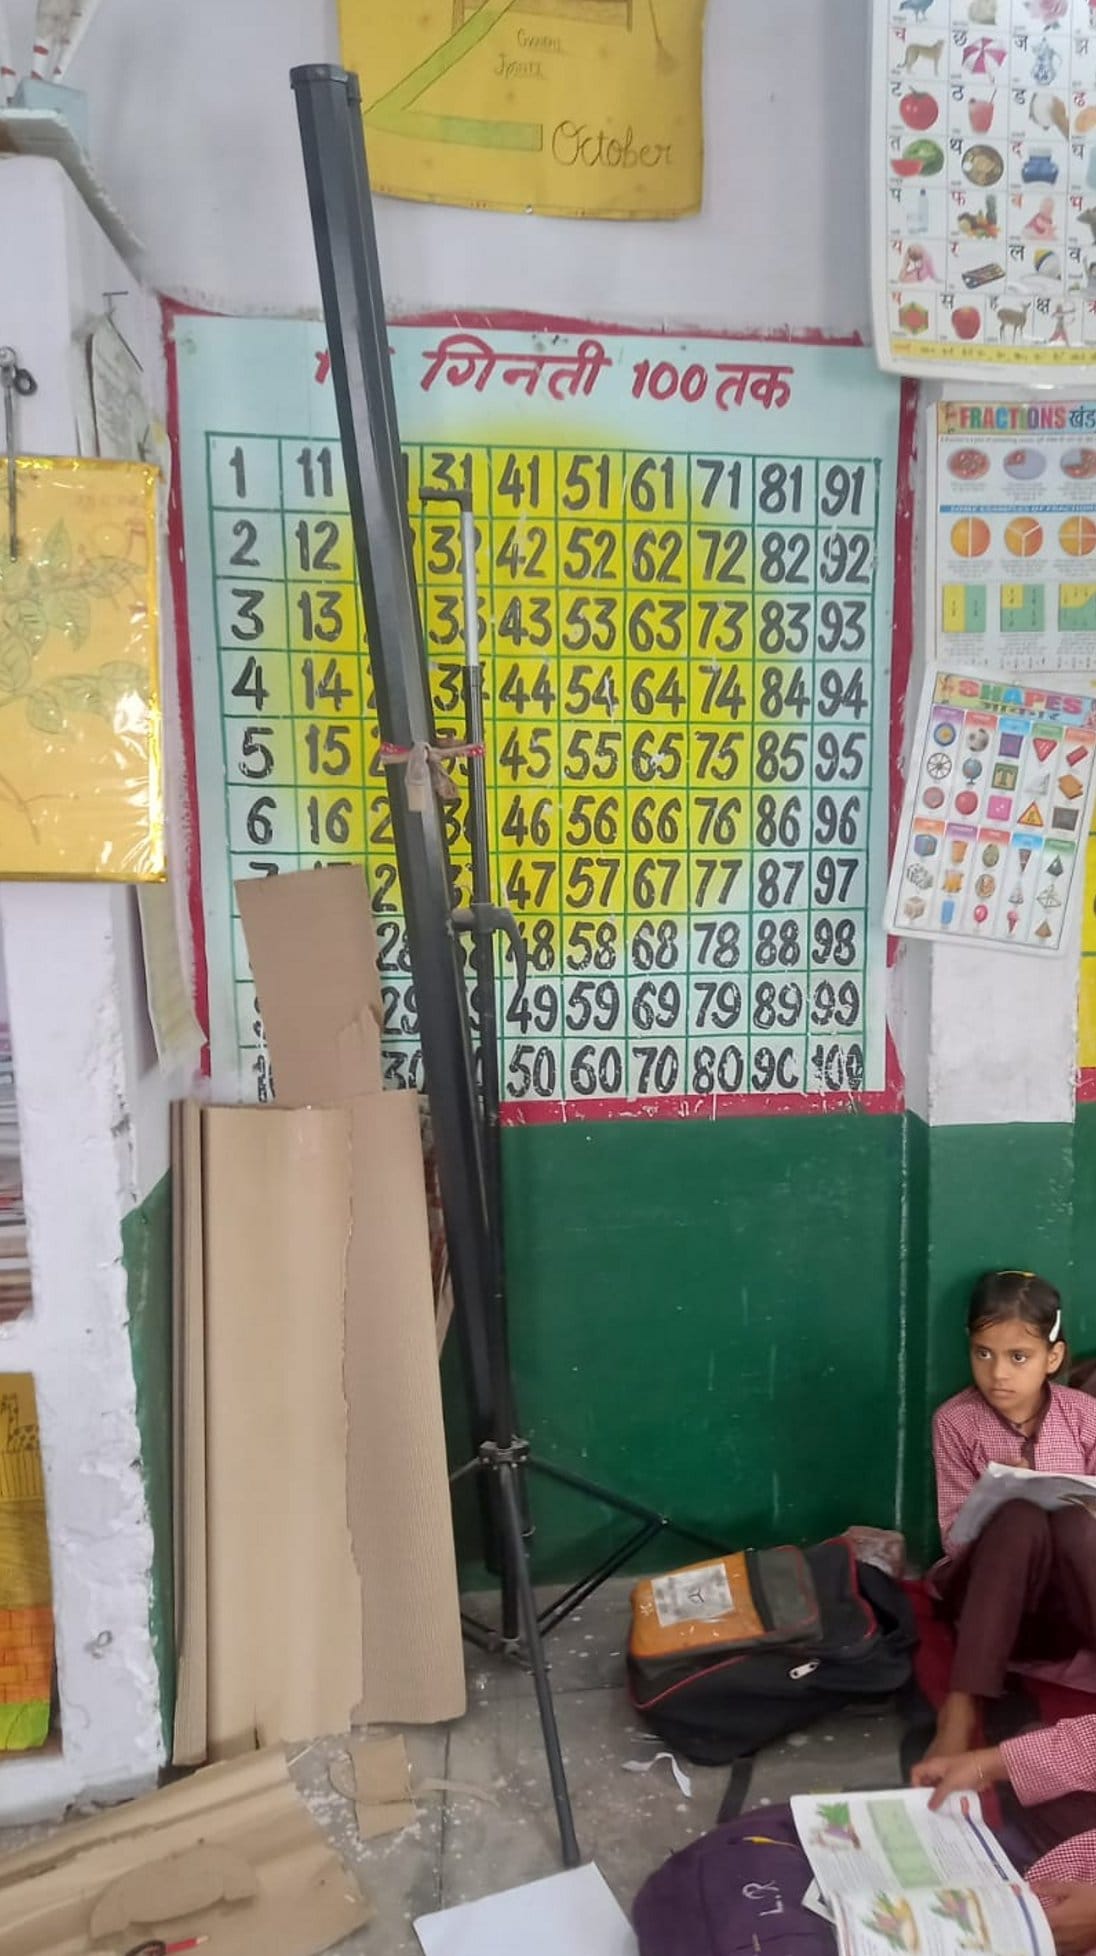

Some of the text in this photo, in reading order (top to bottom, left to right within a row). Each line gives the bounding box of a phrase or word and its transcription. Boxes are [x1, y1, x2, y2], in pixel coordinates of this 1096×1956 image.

[421, 334, 612, 399] गिनती
[632, 358, 708, 403] 100
[715, 363, 794, 412] तक
[959, 406, 1066, 430] FRACTIONS
[230, 446, 246, 498] 1
[297, 447, 333, 497] 11
[497, 454, 540, 508] 41
[562, 454, 609, 509] 51
[630, 457, 674, 512] 61
[697, 459, 741, 509] 71
[759, 464, 802, 514] 81
[821, 465, 865, 516] 91
[230, 520, 260, 567] 2
[295, 520, 341, 571] 12
[496, 527, 547, 579] 42
[564, 528, 616, 580] 52
[632, 528, 682, 582] 62
[697, 530, 747, 583] 72
[760, 532, 809, 583] 82
[820, 531, 870, 583] 92
[231, 588, 264, 640] 3
[298, 589, 343, 642] 13
[498, 596, 552, 646] 43
[563, 597, 616, 650] 53
[629, 600, 686, 651] 63
[698, 600, 748, 650] 73
[759, 602, 811, 653] 83
[818, 601, 866, 652] 93
[231, 656, 269, 710] 4
[302, 658, 352, 711] 14
[499, 663, 555, 714] 44
[565, 665, 617, 716] 54
[631, 666, 686, 716] 64
[699, 664, 745, 718] 74
[760, 667, 810, 718] 84
[818, 666, 867, 719] 94
[959, 679, 1083, 715] SHAPES
[239, 727, 274, 778] 5
[306, 724, 350, 776] 15
[500, 727, 552, 781] 45
[565, 730, 621, 780] 55
[632, 730, 683, 782] 65
[696, 731, 744, 780] 75
[756, 731, 808, 782] 85
[816, 731, 865, 781] 95
[246, 797, 276, 844] 6
[308, 797, 352, 844] 16
[503, 795, 552, 848] 46
[566, 796, 618, 846] 56
[632, 797, 681, 845] 66
[695, 797, 741, 845] 76
[756, 795, 800, 847] 86
[816, 796, 860, 845] 96
[507, 860, 556, 909] 47
[566, 857, 619, 907] 57
[634, 858, 681, 908] 67
[696, 860, 742, 907] 77
[759, 859, 803, 908] 87
[815, 856, 858, 905] 97
[567, 921, 616, 970] 58
[633, 920, 678, 970] 68
[695, 921, 740, 968] 78
[756, 919, 799, 968] 88
[813, 918, 855, 966] 98
[507, 984, 557, 1033] 49
[566, 980, 619, 1033] 59
[632, 980, 681, 1030] 69
[695, 982, 741, 1029] 79
[753, 982, 801, 1029] 89
[812, 980, 860, 1027] 99
[508, 1044, 555, 1097] 50
[571, 1045, 621, 1094] 60
[633, 1045, 678, 1094] 70
[694, 1046, 744, 1093] 80
